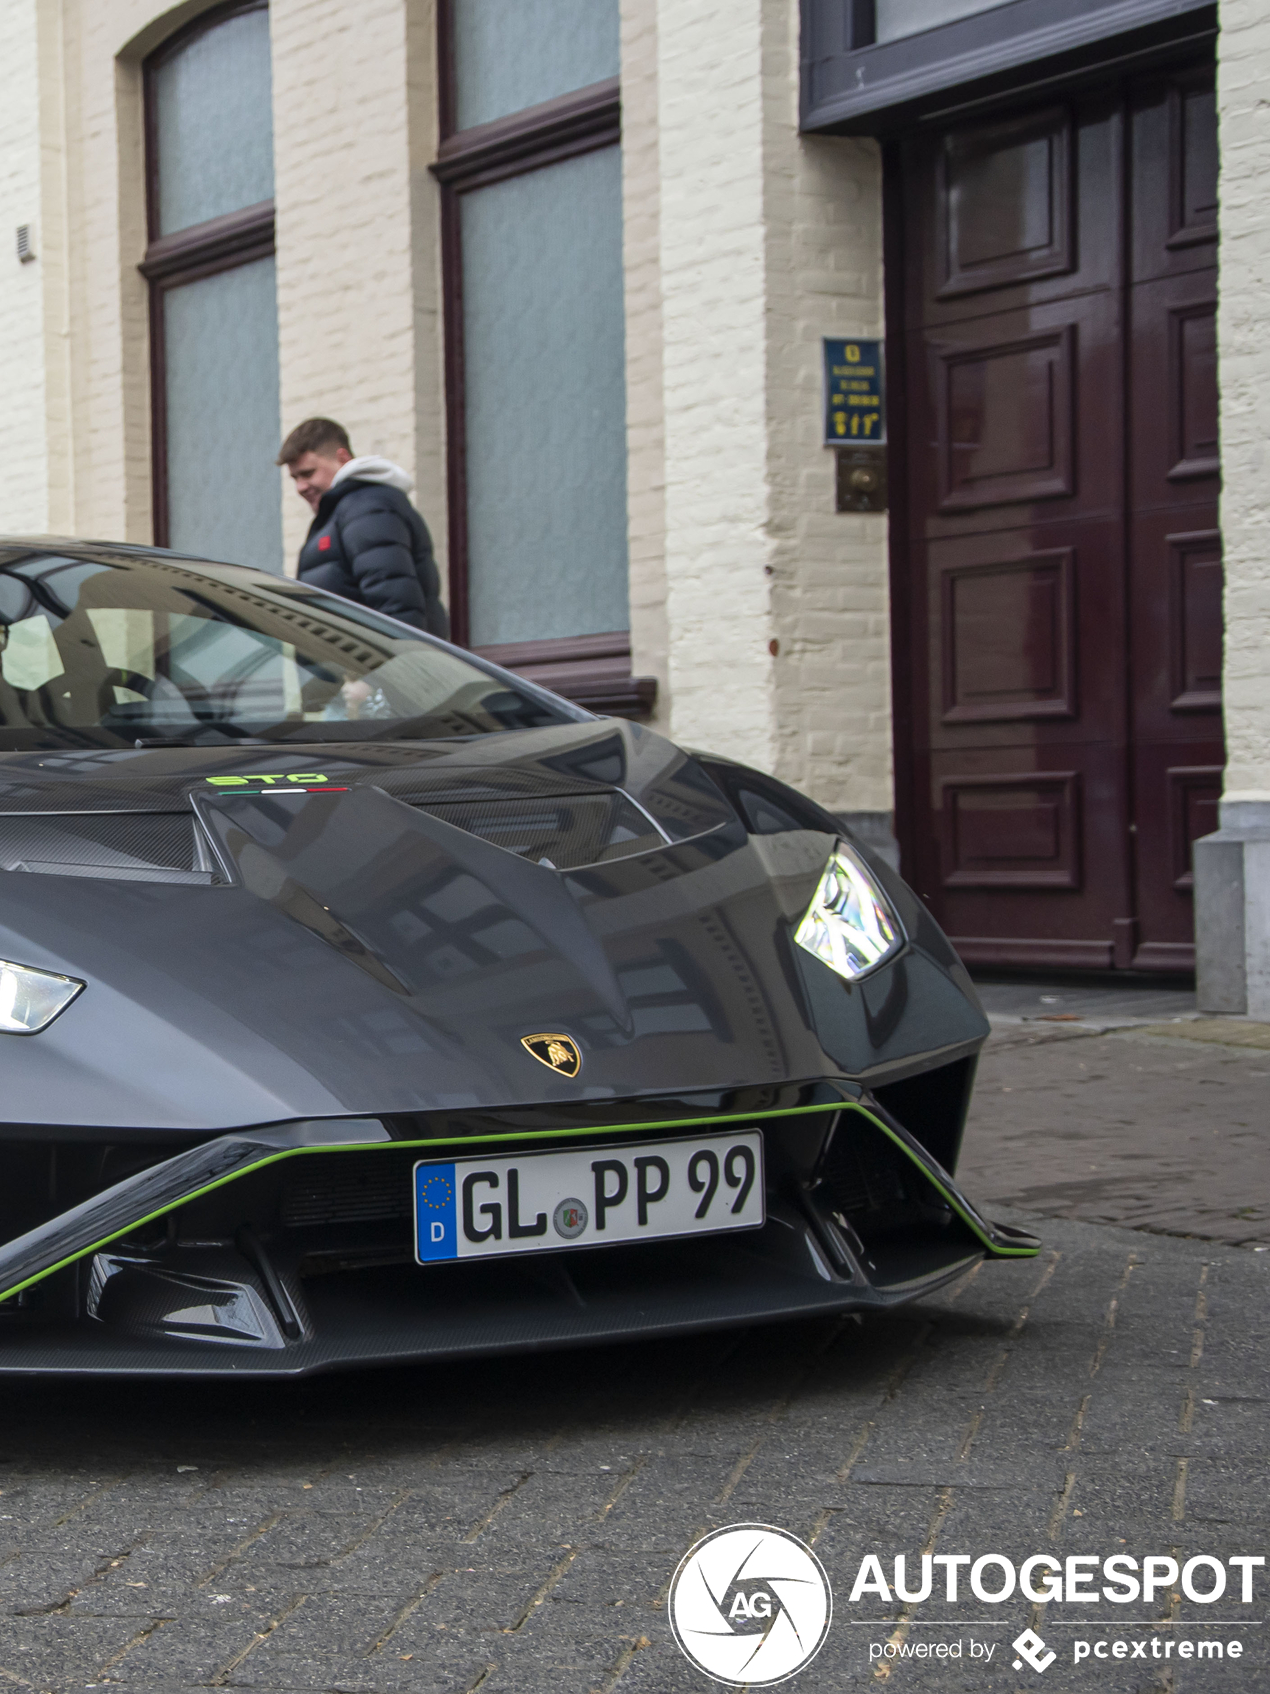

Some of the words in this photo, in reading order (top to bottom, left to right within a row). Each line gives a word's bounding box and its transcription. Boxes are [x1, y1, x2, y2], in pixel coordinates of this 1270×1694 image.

[205, 773, 328, 786] STO
[462, 1168, 547, 1243] GL
[591, 1155, 669, 1230] PP
[687, 1144, 755, 1220] 99
[431, 1222, 445, 1243] D
